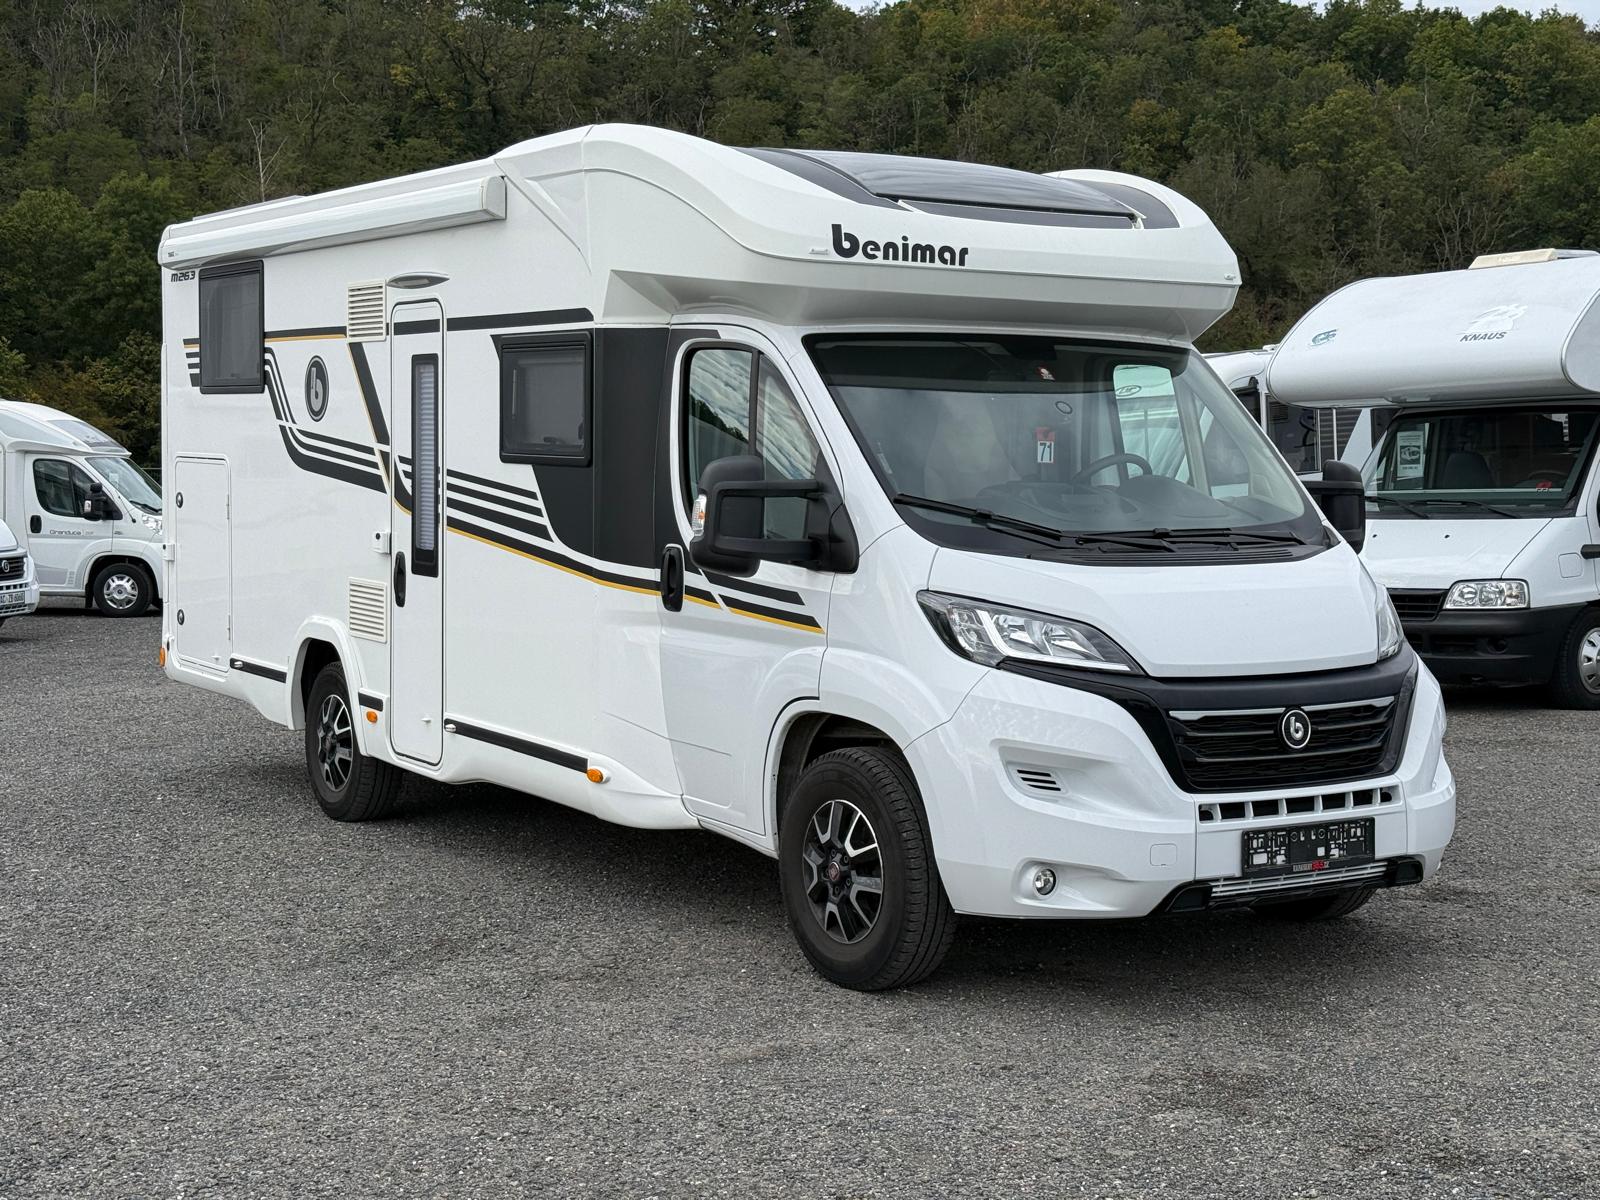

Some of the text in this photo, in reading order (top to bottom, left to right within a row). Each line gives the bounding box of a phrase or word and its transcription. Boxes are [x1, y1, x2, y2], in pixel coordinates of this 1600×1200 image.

[831, 223, 969, 267] benimar
[1459, 331, 1507, 342] KNAUS
[1038, 442, 1053, 462] 71
